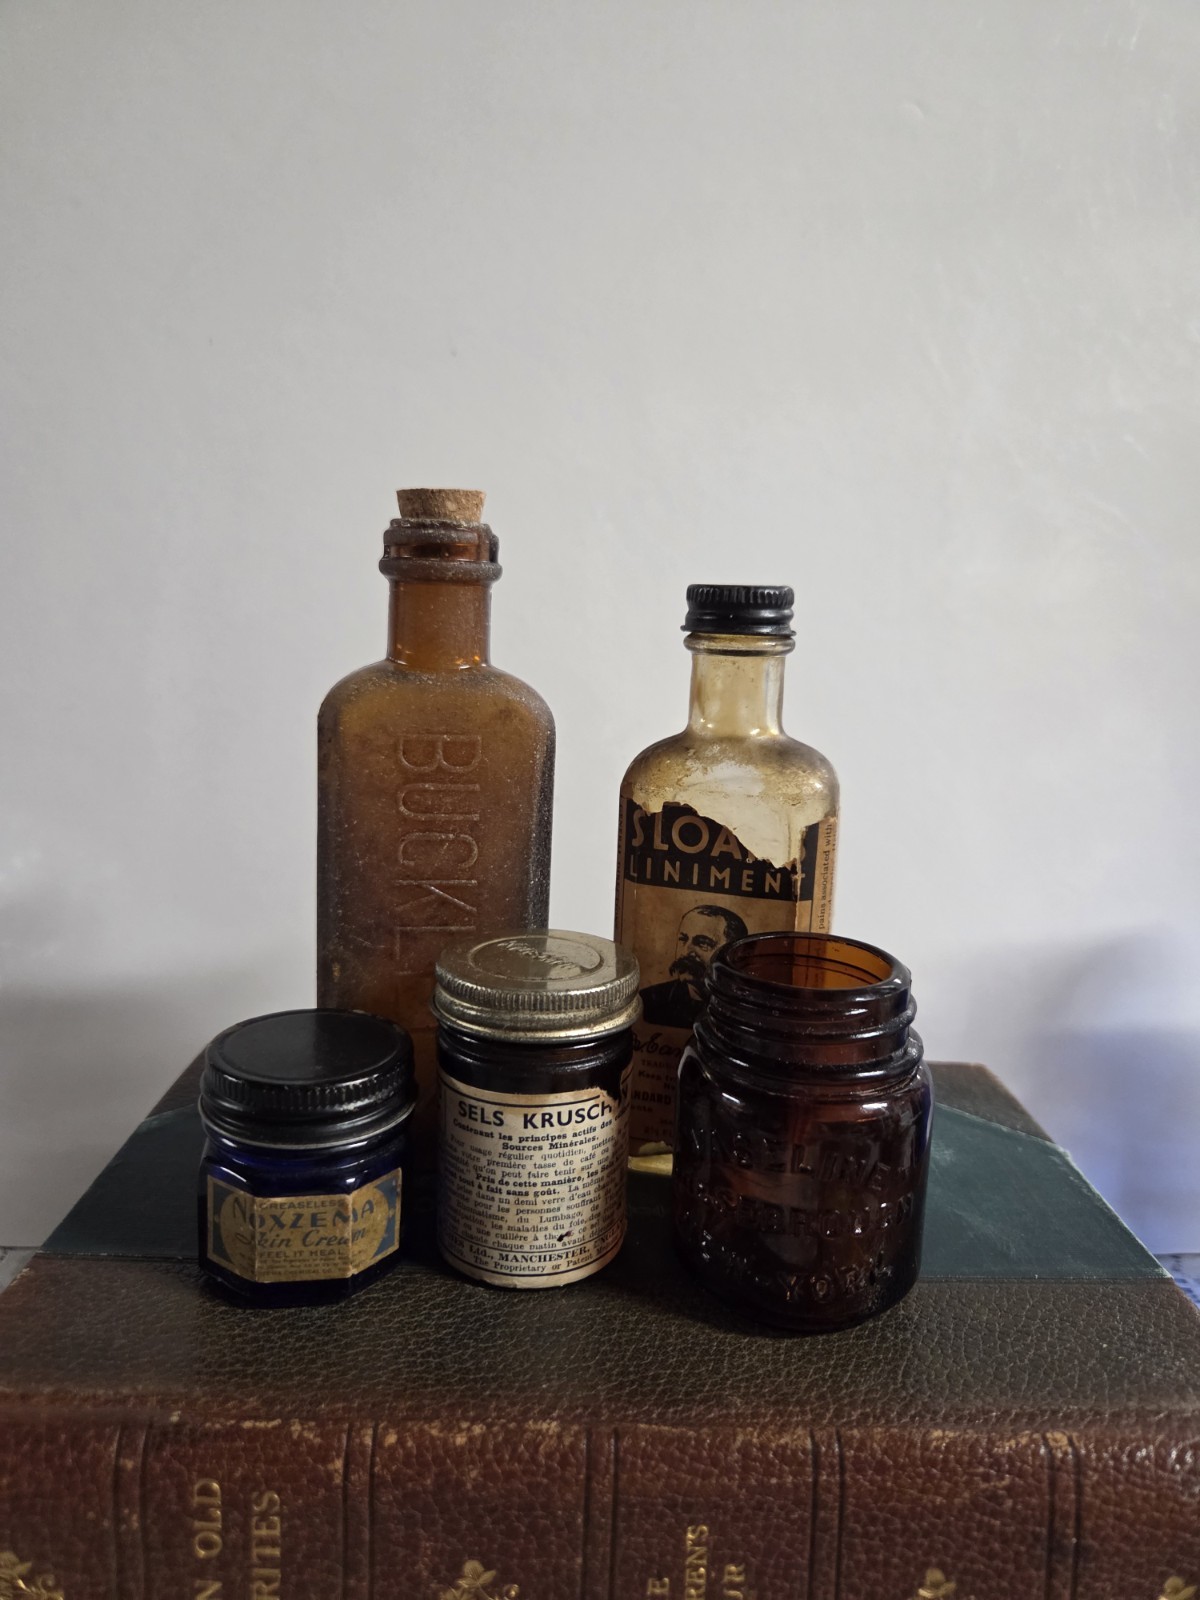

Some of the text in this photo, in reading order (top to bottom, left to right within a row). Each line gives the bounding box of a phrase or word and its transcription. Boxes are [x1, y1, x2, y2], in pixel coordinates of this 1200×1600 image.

[632, 808, 757, 861] SLOA
[395, 734, 481, 976] BUCKL
[817, 823, 833, 930] pains associated with
[631, 1090, 672, 1105] NDARD
[458, 1100, 505, 1127] SELS
[453, 1118, 613, 1144] Contenant les principes actifs des
[470, 1145, 493, 1156] usage
[498, 1150, 534, 1162] régulier
[540, 1148, 586, 1161] quotidien,
[502, 1136, 600, 1152] Sources Minérales.
[472, 1164, 497, 1175] qu'on
[501, 1170, 521, 1181] peut
[527, 1169, 549, 1179] faire
[554, 1166, 576, 1177] tenir
[580, 1161, 593, 1172] sur
[487, 1156, 527, 1170] première
[533, 1161, 557, 1170] tasse
[563, 1156, 574, 1166] de
[580, 1151, 596, 1164] café
[459, 1175, 475, 1187] tout
[486, 1184, 503, 1195] fait
[506, 1188, 530, 1197] sans
[533, 1186, 560, 1198] goût.
[568, 1184, 579, 1193] La
[476, 1173, 495, 1184] Pris
[498, 1178, 510, 1186] de
[513, 1179, 538, 1188] cette
[540, 1174, 585, 1188] manière,
[587, 1169, 600, 1180] les
[473, 1200, 493, 1211] pour
[497, 1205, 510, 1214] les
[516, 1205, 561, 1216] personnes
[566, 1195, 601, 1212] souffrant
[475, 1190, 495, 1202] dans
[498, 1197, 510, 1205] un
[514, 1195, 538, 1206] demi
[542, 1195, 565, 1205] verre
[569, 1190, 592, 1202] d'eau
[233, 1197, 375, 1232] NOXZEMA
[516, 1215, 529, 1224] du
[590, 1203, 600, 1213] de
[303, 1226, 367, 1247] Cream
[476, 1226, 491, 1237] une
[491, 1220, 503, 1231] les
[507, 1223, 549, 1233] maladies
[552, 1220, 565, 1231] du
[491, 1239, 525, 1252] chaque
[529, 1241, 557, 1250] matin
[562, 1235, 586, 1247] avant
[473, 1253, 594, 1273] The Proprietary or Patent
[193, 1477, 223, 1559] OLD
[250, 1490, 281, 1600] RITES
